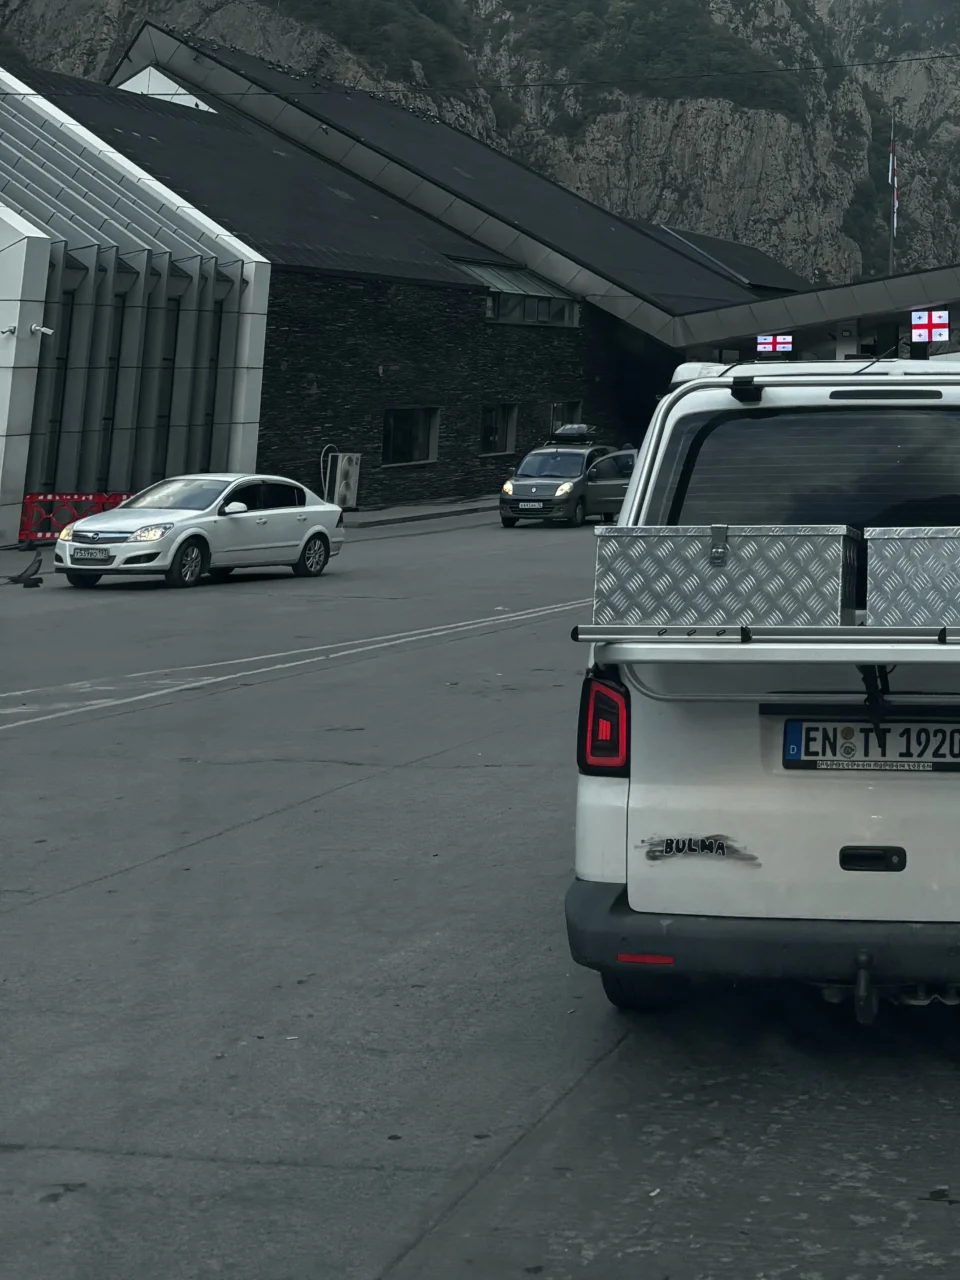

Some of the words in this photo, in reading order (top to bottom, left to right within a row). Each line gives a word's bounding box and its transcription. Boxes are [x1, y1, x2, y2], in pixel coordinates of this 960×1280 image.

[789, 745, 797, 755] D
[803, 726, 838, 757] EN
[664, 837, 726, 856] BULMA
